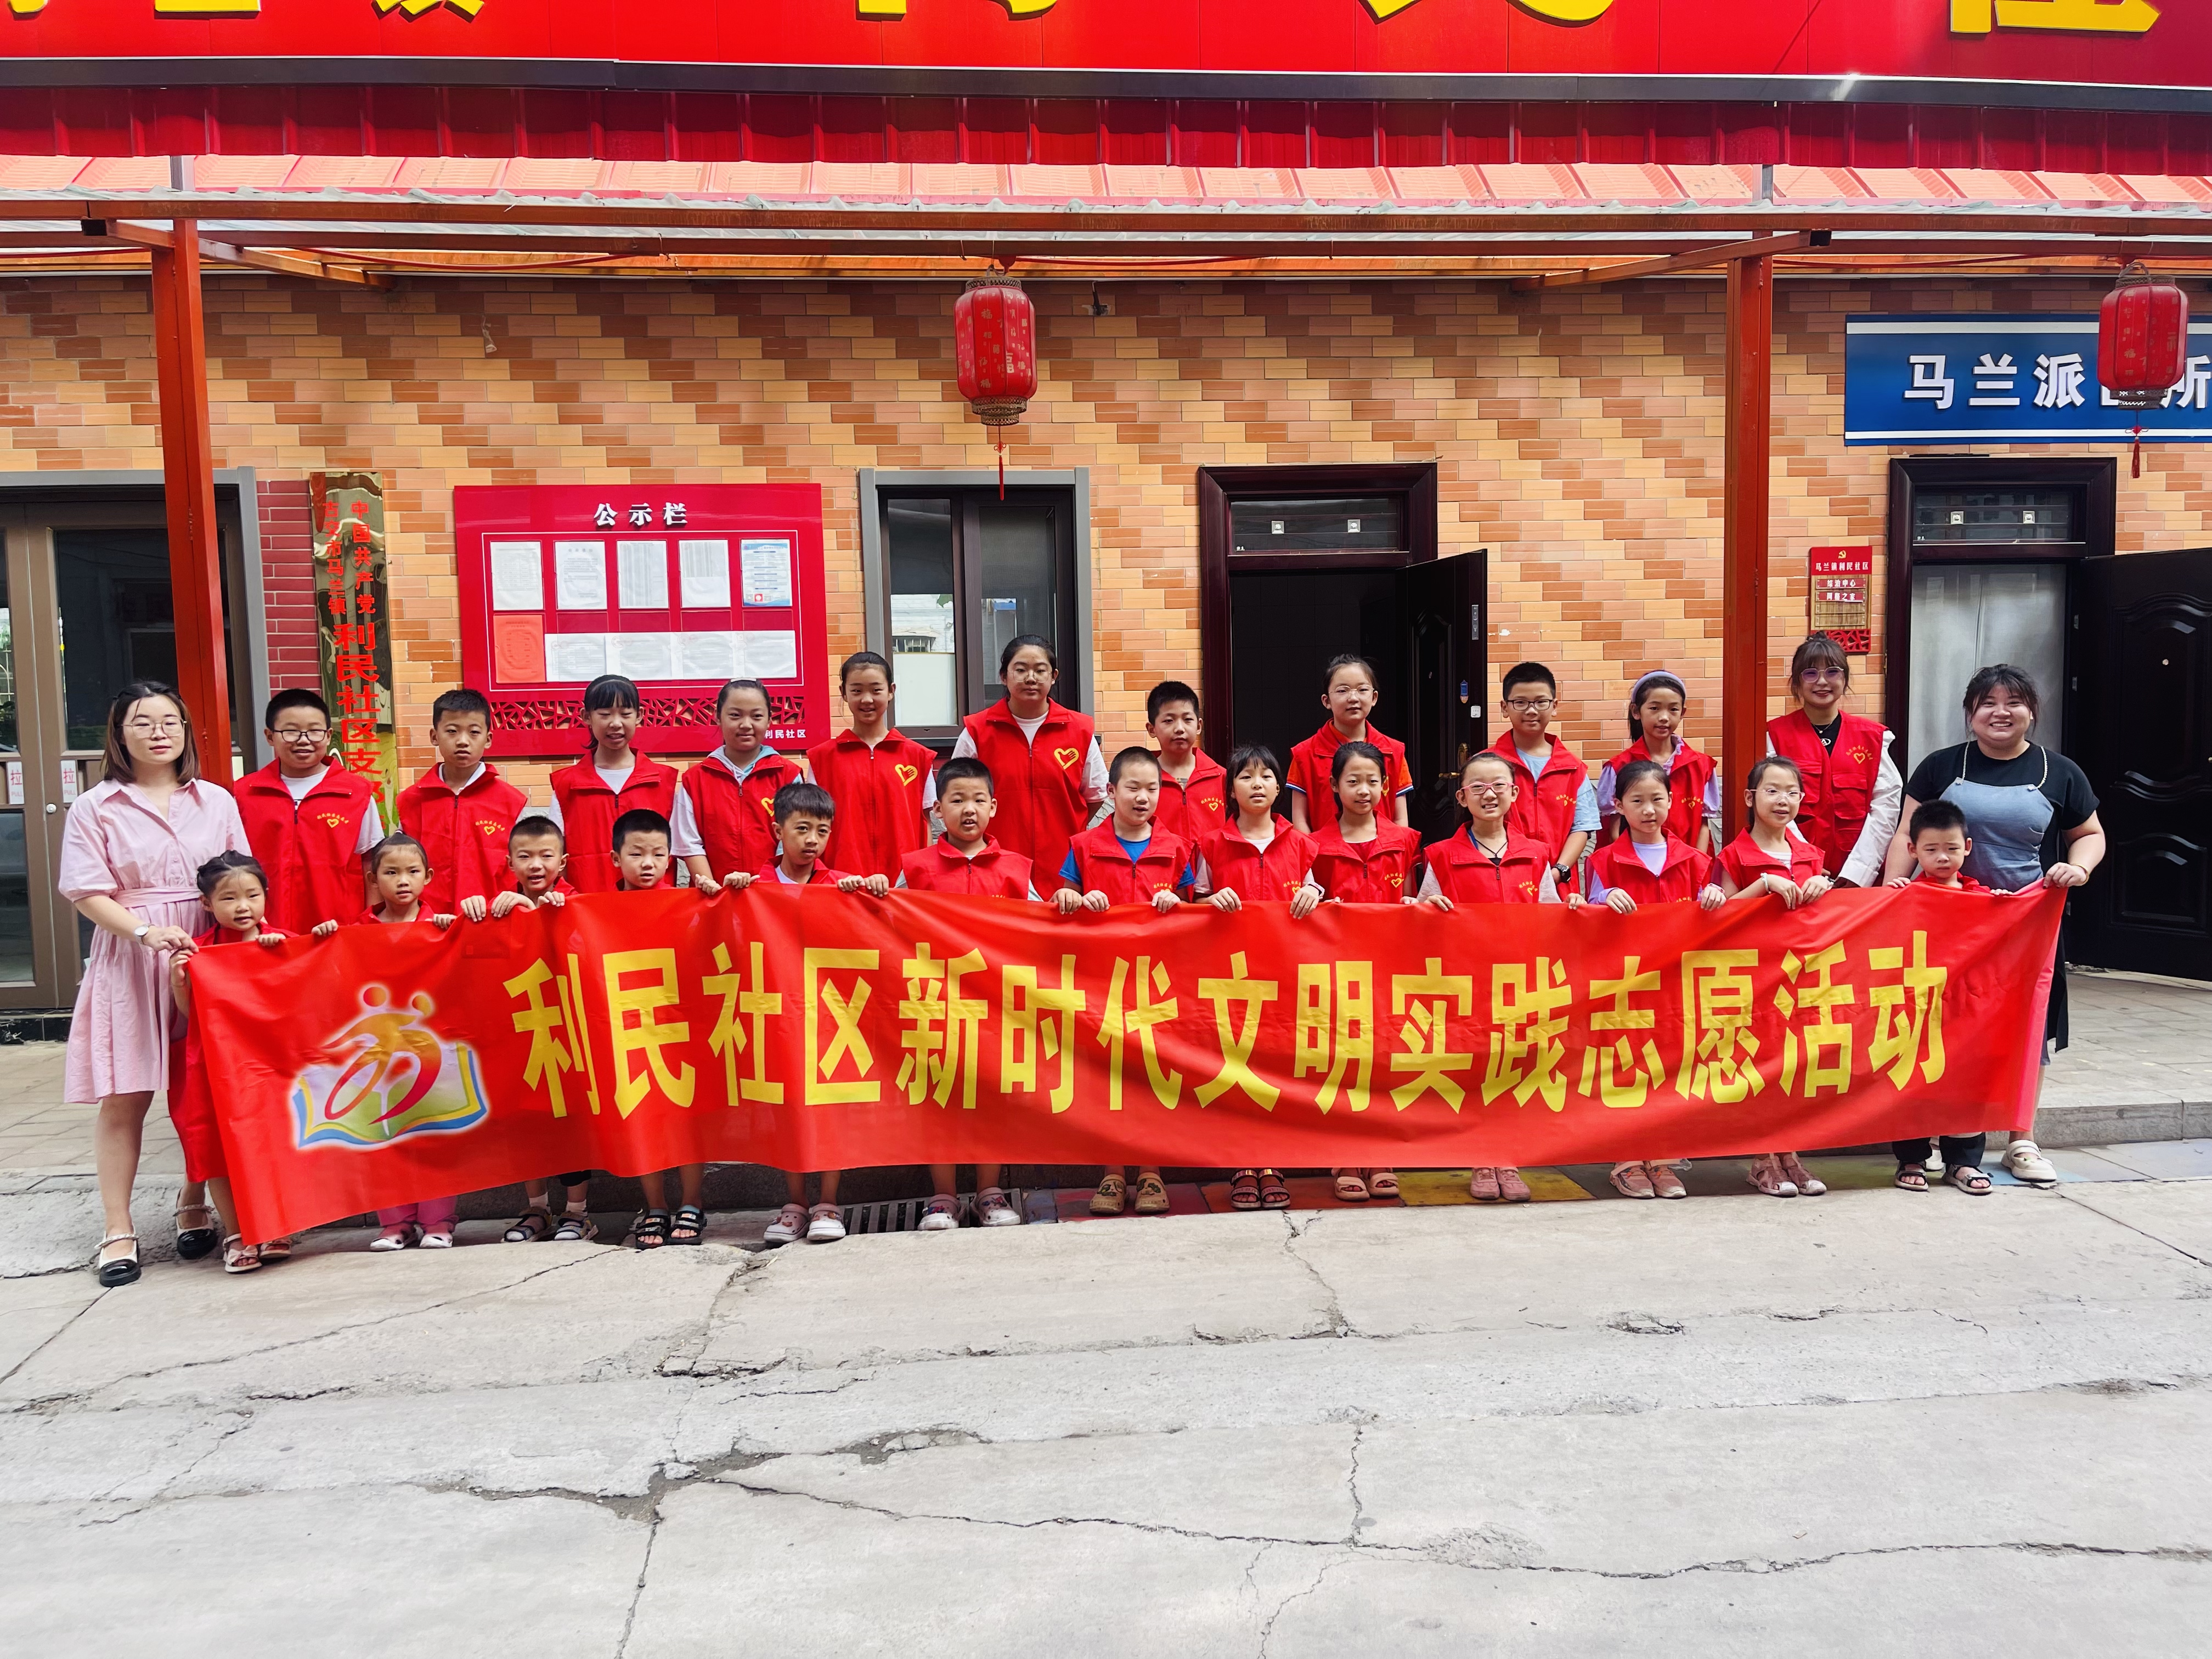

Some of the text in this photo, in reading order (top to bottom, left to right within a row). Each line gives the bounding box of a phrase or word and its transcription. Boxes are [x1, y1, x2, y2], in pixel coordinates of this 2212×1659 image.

[1904, 352, 2211, 410] 马兰派所
[594, 502, 688, 526] 公示栏
[323, 500, 347, 614] 古交市马兰镇
[351, 500, 376, 614] 中国共产党
[765, 729, 806, 739] 利民社区
[10, 769, 22, 786] 拉
[63, 768, 75, 784] 拉
[503, 930, 1948, 1120] 利民社区新时代文明实践志愿活动
